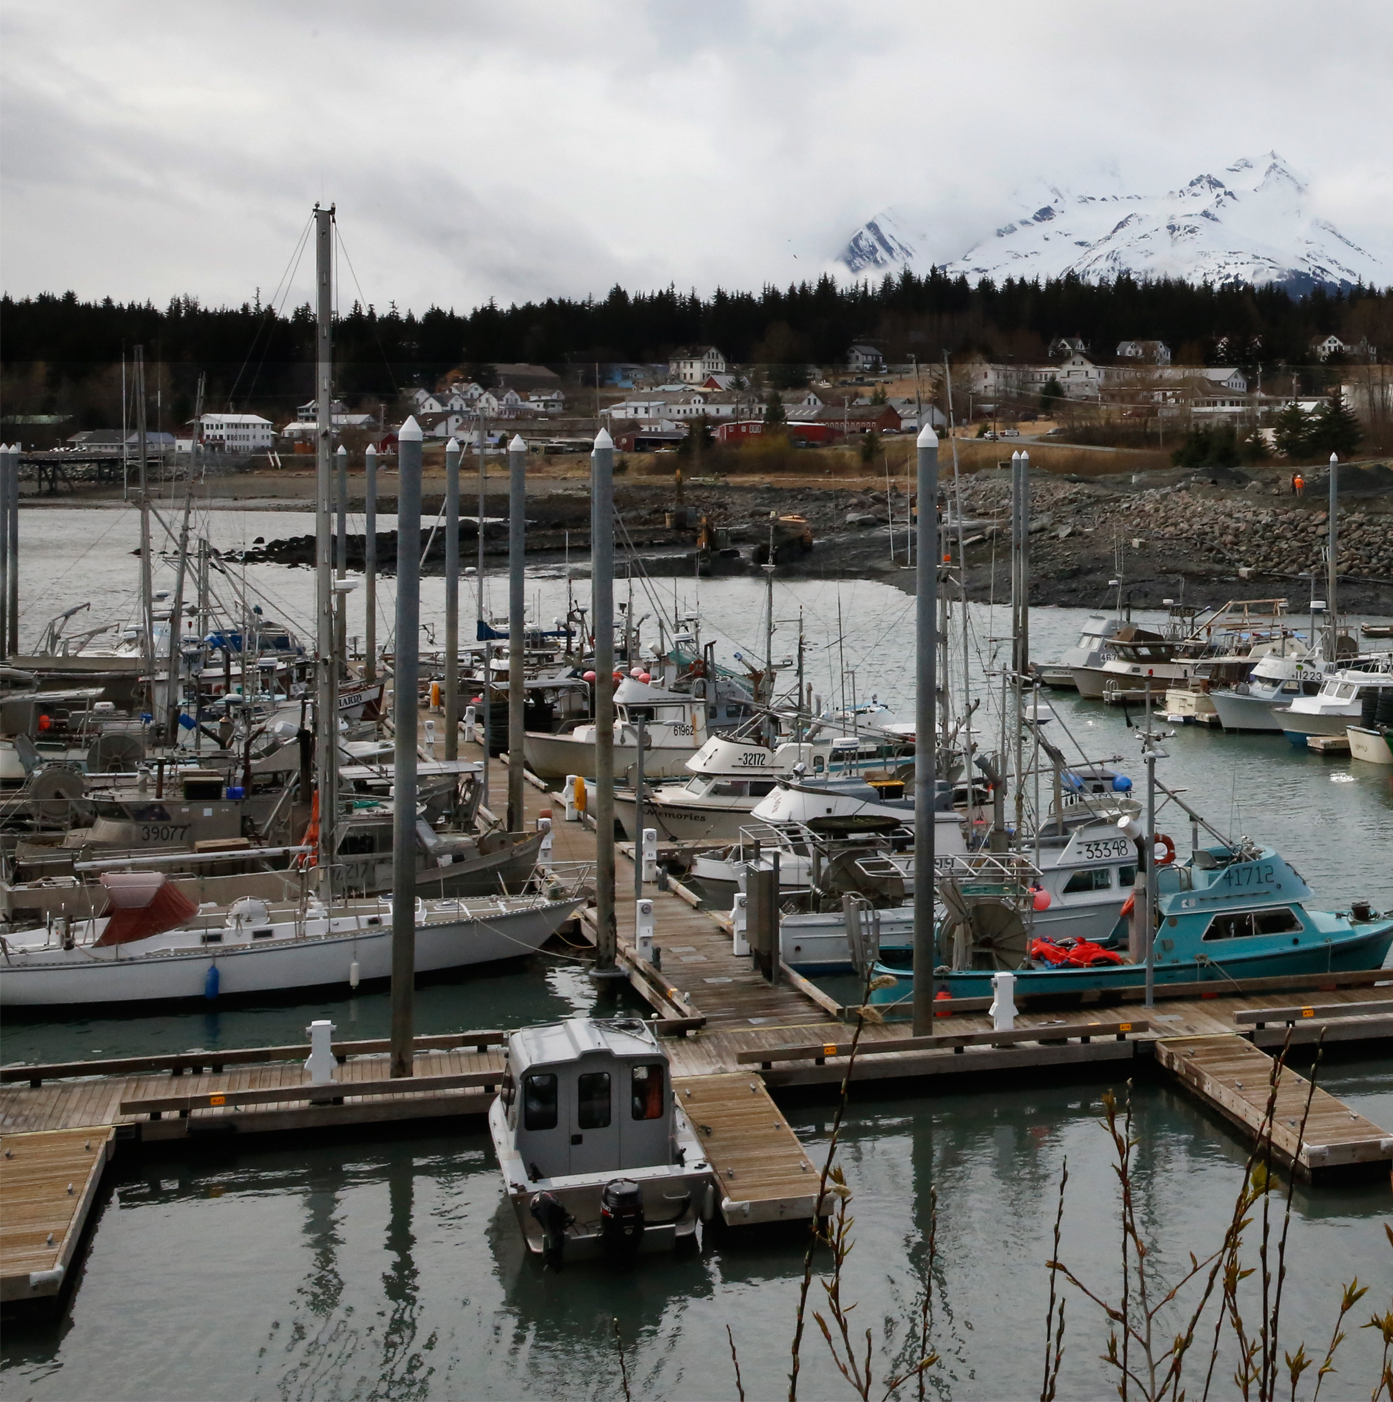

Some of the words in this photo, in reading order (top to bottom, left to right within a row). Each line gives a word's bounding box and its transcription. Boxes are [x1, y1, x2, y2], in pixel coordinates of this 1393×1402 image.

[674, 725, 694, 736] 61962
[644, 808, 706, 822] Memories
[141, 825, 188, 841] 39077
[1223, 865, 1275, 887] 41712
